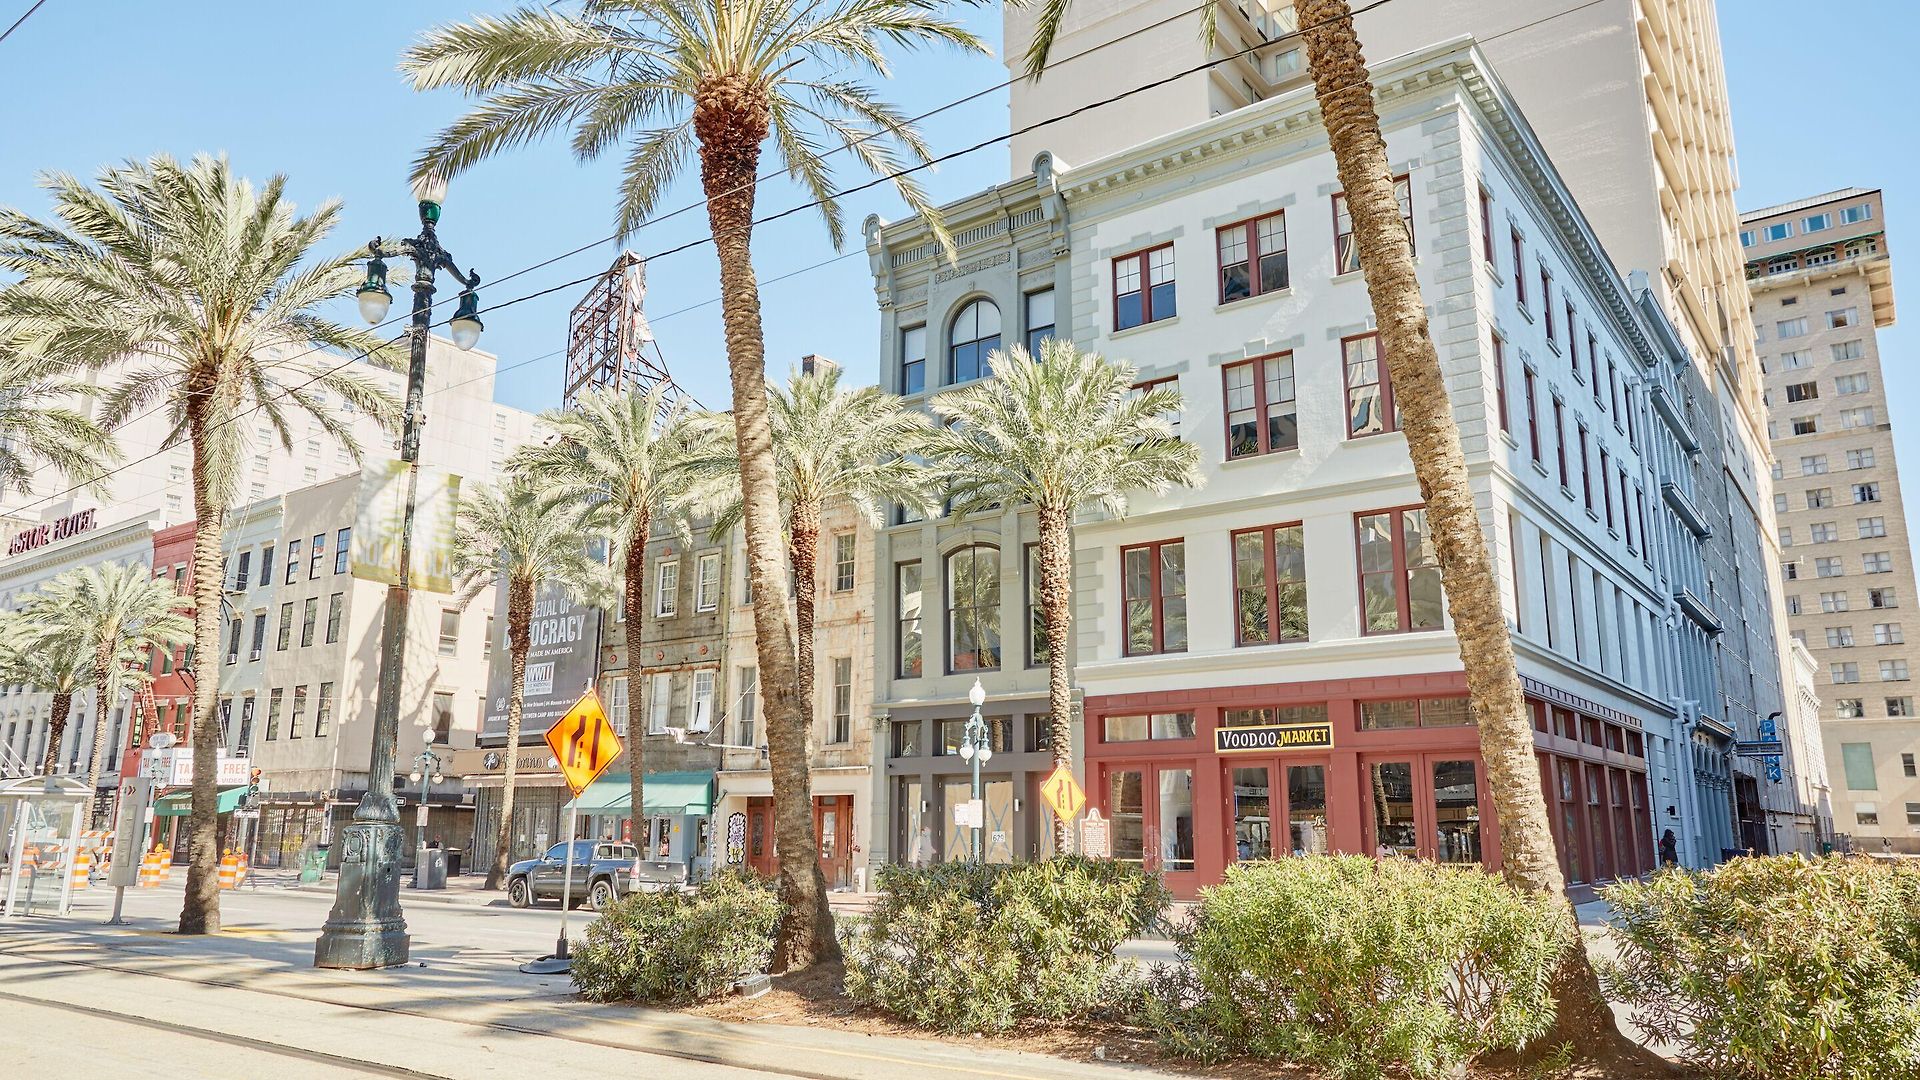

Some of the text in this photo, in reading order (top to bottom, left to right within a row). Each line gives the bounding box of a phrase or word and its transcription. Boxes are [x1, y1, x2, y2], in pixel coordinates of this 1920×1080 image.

[7, 508, 97, 556] ASTOR HOTEL
[530, 650, 543, 658] MADE
[550, 647, 573, 655] AMERICA
[1222, 729, 1328, 748] VOODOO MARKET
[178, 763, 247, 774] TA FREE
